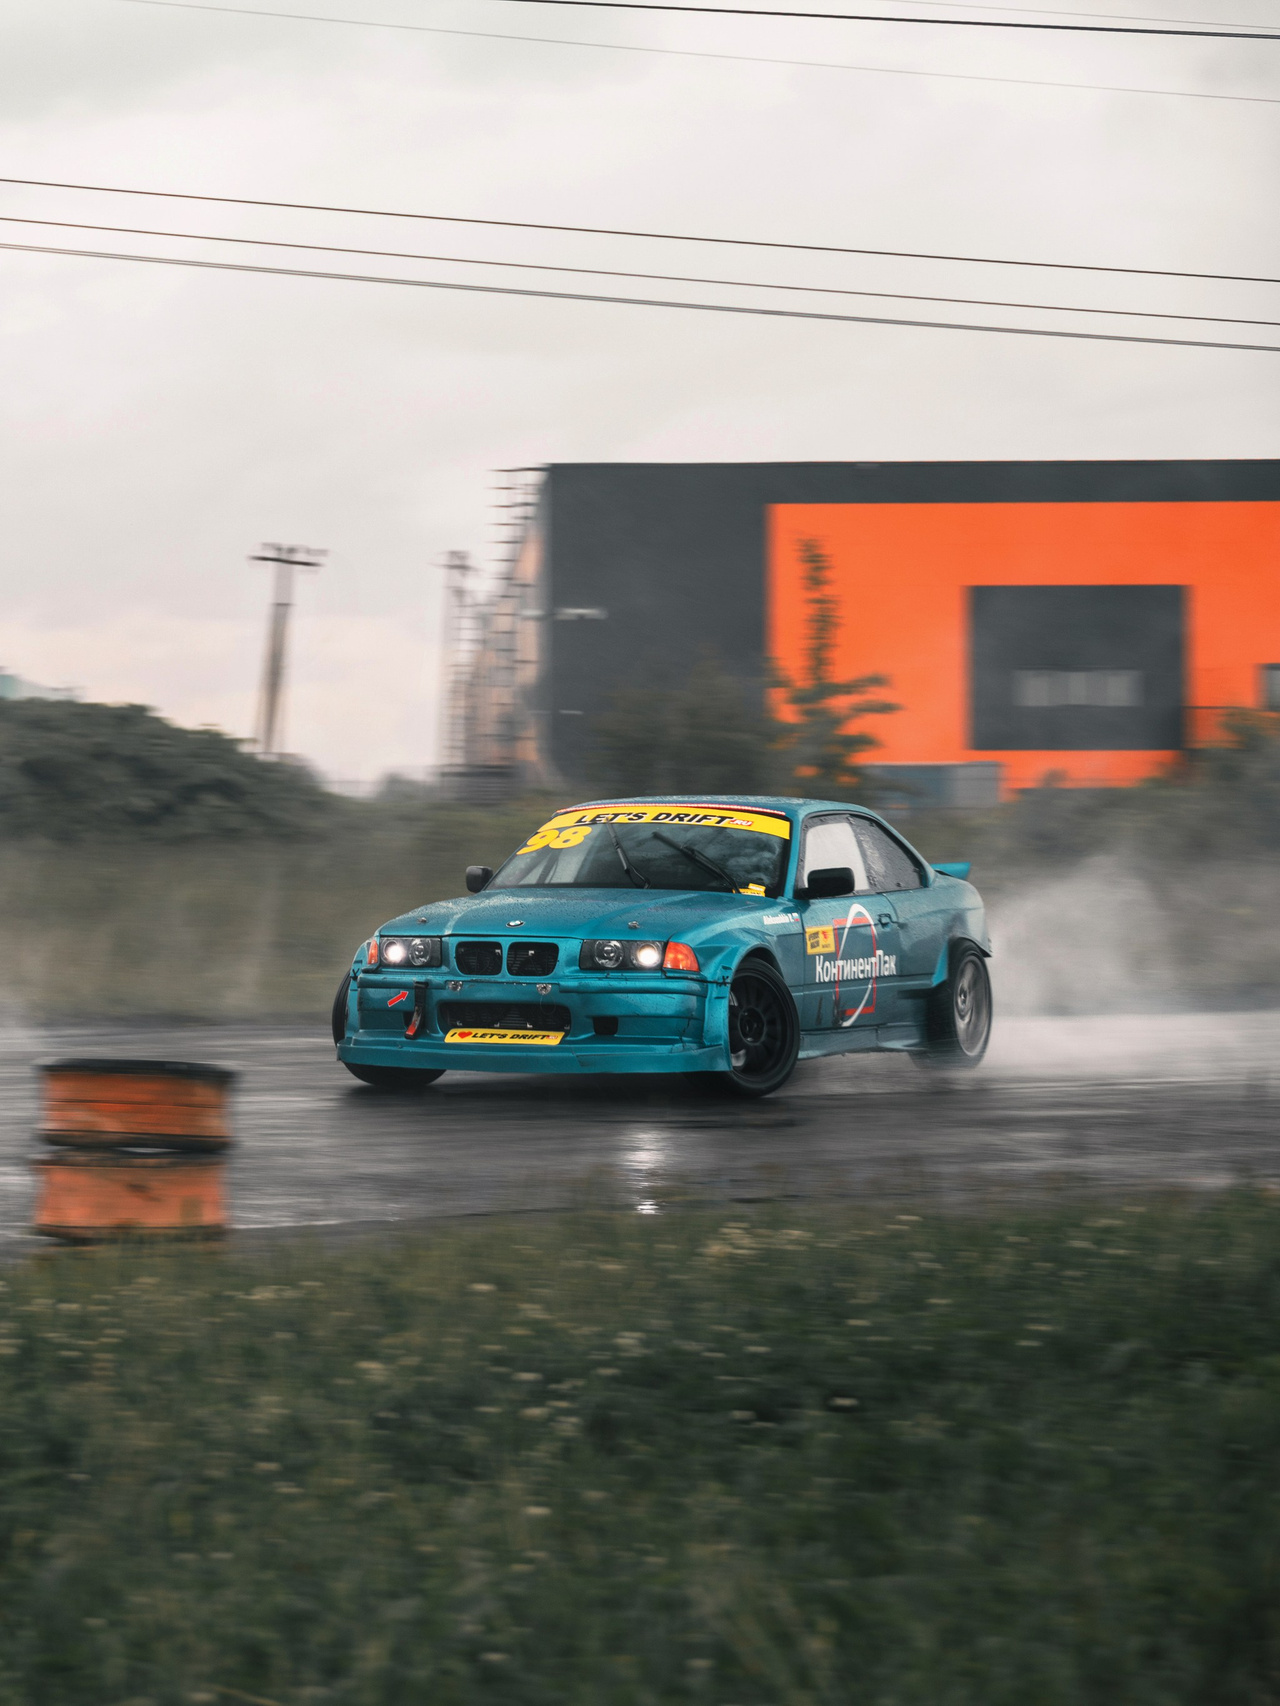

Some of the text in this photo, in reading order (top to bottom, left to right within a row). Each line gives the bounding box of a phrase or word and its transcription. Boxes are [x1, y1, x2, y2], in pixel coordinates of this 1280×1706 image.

[575, 812, 648, 824] LET'S
[516, 825, 593, 855] 98
[815, 950, 897, 983] КонтинентПак
